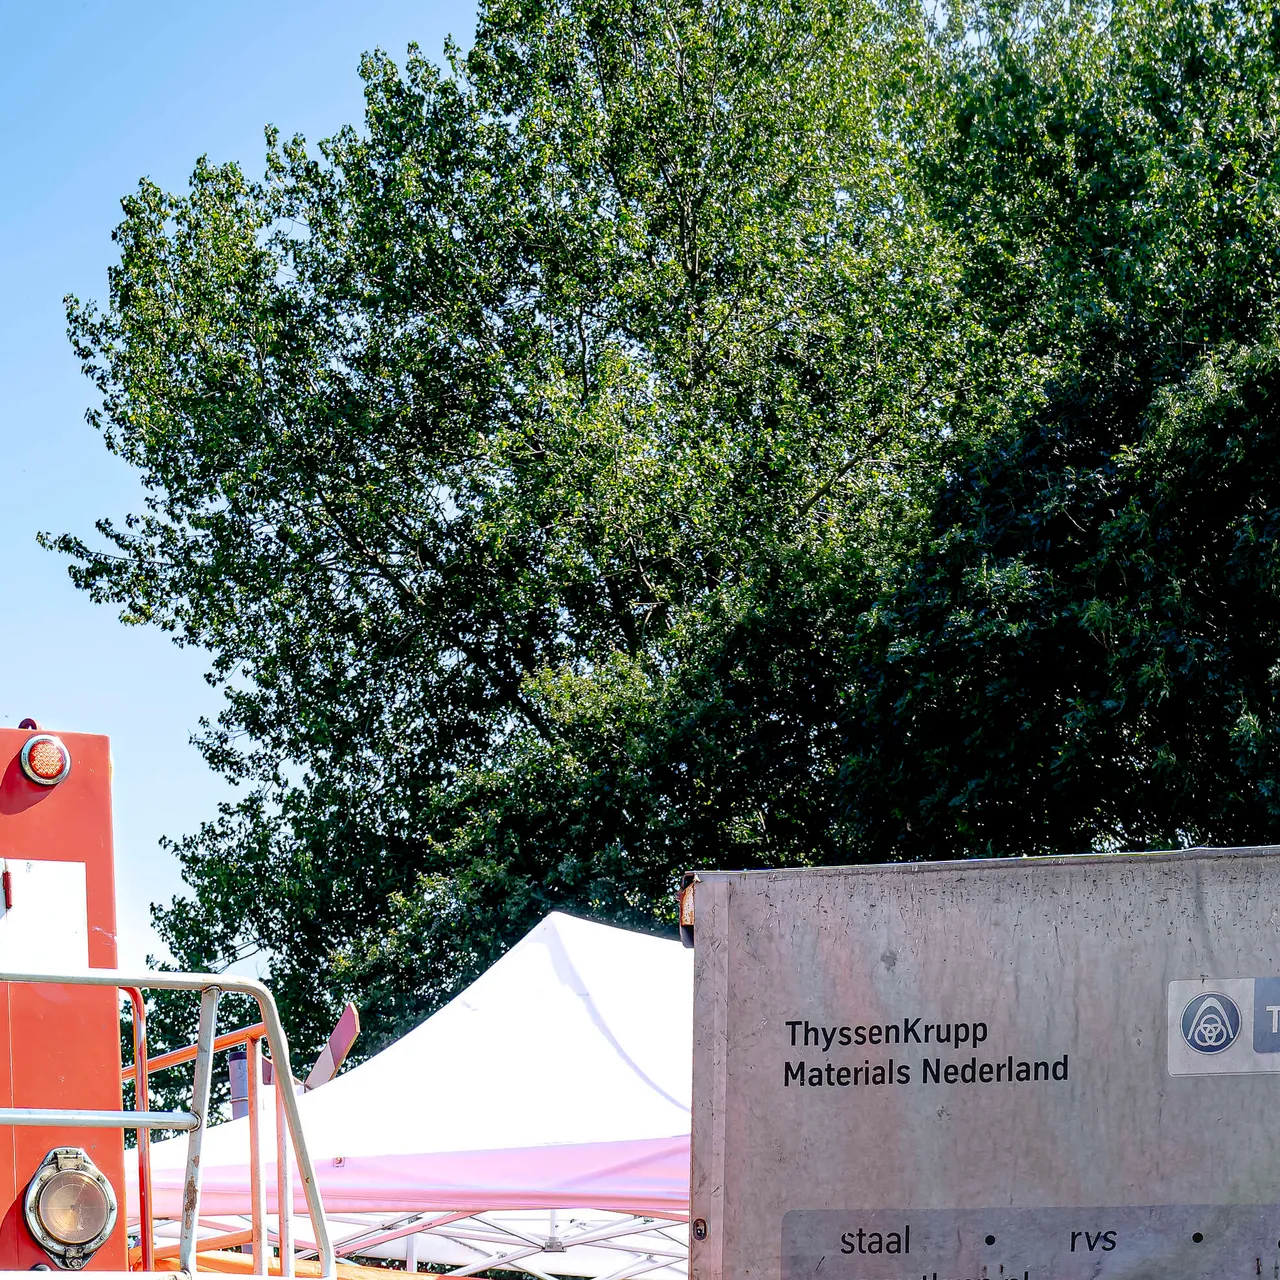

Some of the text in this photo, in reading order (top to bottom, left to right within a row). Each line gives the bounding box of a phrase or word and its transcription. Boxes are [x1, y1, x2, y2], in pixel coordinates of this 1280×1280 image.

[785, 1017, 989, 1051] ThyssenKrupp
[783, 1055, 1070, 1087] Materials Nederland
[840, 1225, 911, 1254] staal
[1070, 1230, 1118, 1253] rvs
